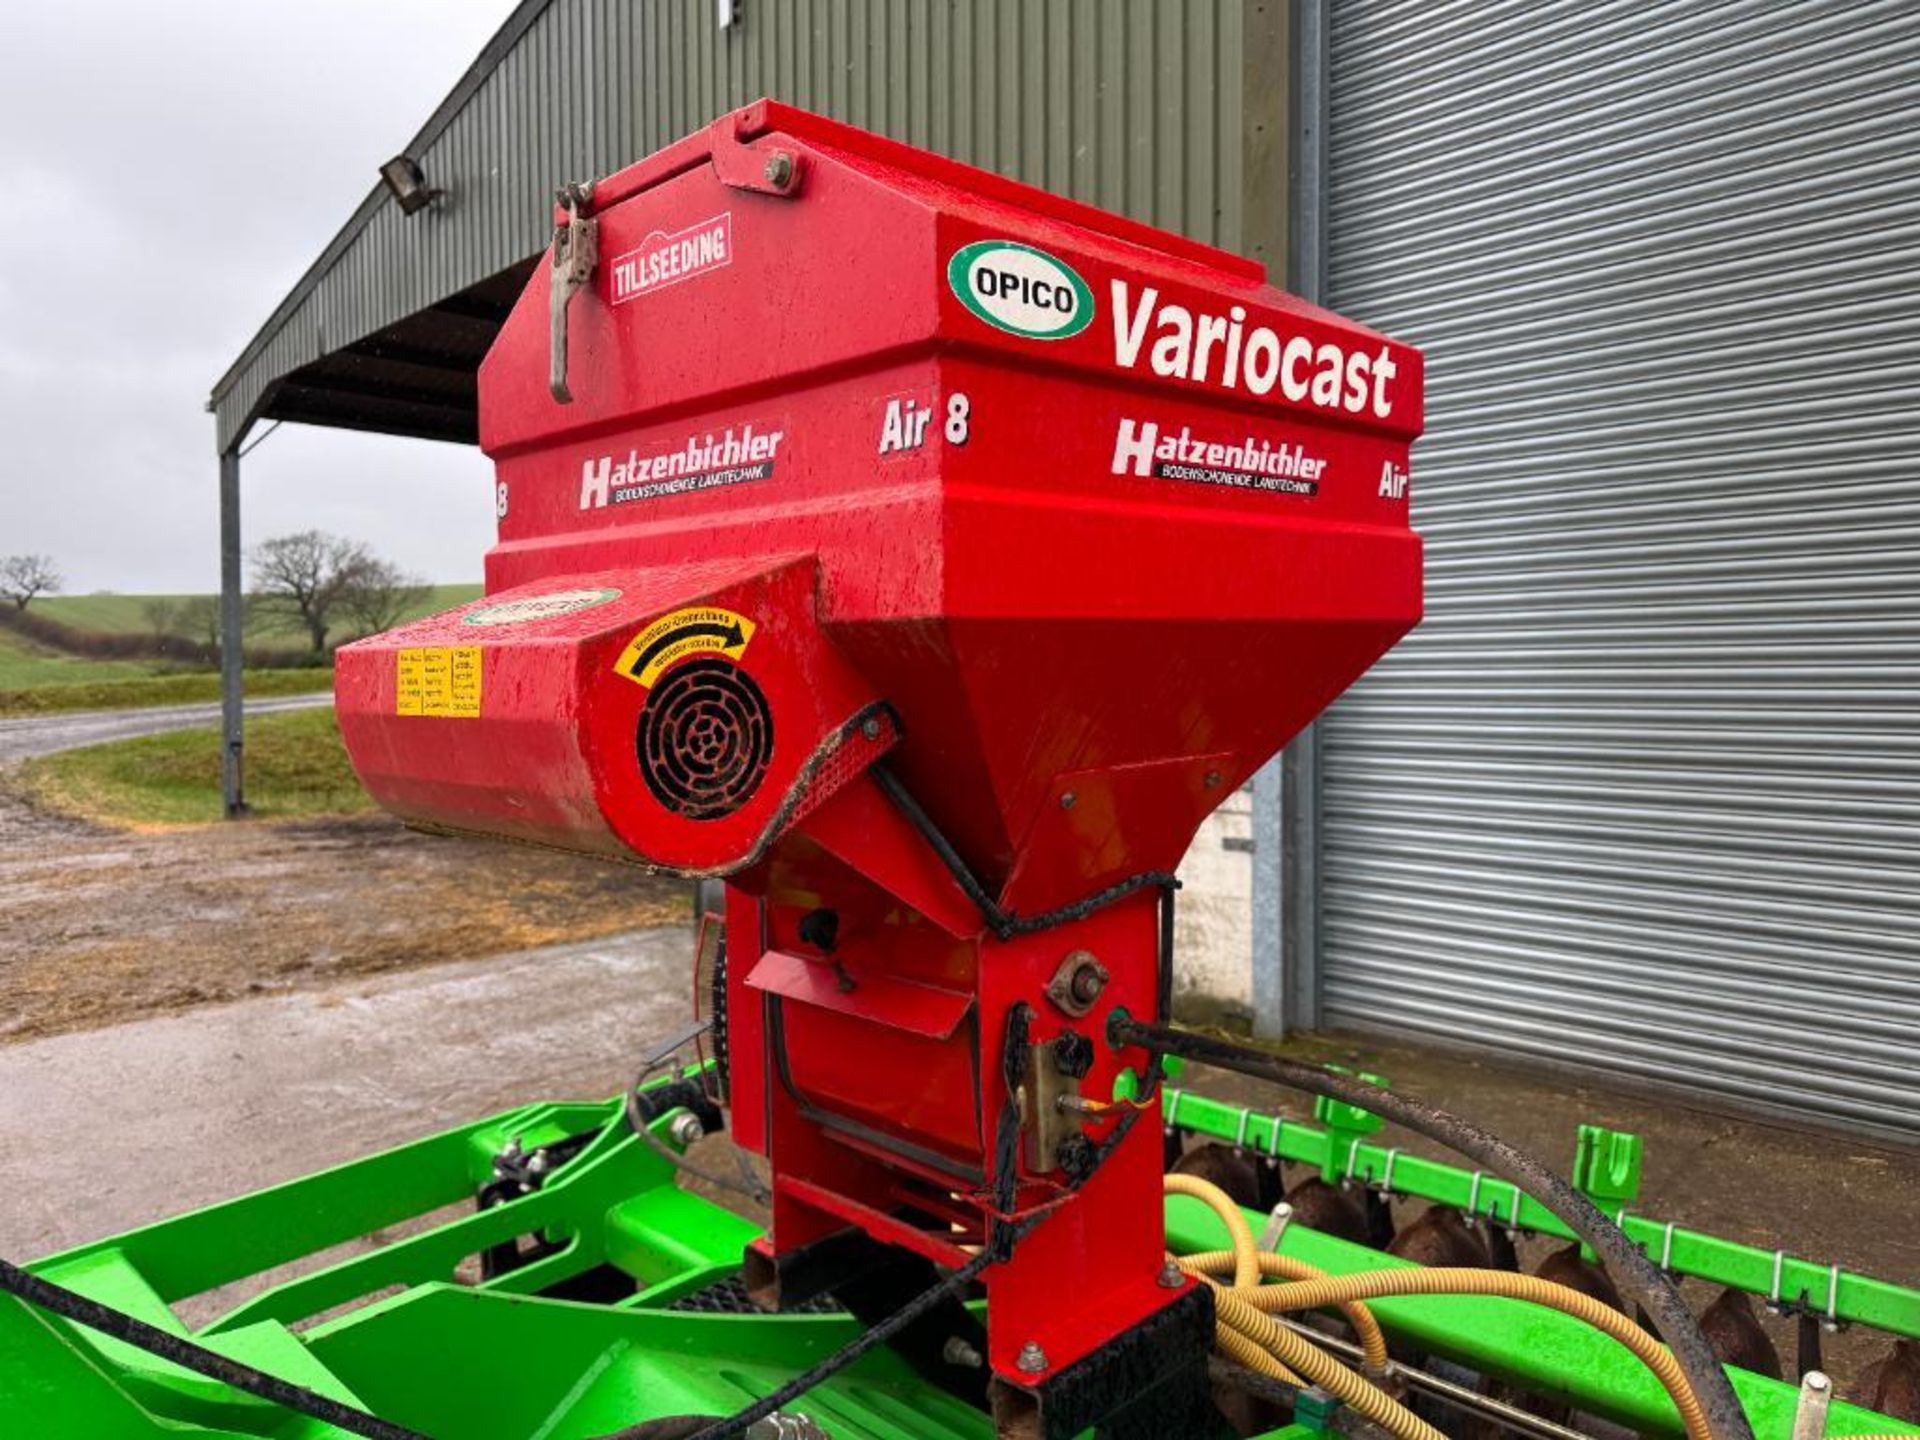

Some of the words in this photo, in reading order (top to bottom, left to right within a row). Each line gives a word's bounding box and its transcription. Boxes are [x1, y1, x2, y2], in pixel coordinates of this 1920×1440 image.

[615, 226, 725, 297] TILLSEEDING
[976, 266, 1073, 313] OPICO
[1110, 278, 1397, 419] Variocast
[879, 399, 932, 454] Air
[944, 392, 970, 445] 8
[1110, 418, 1327, 481] Hatzenbichler
[579, 425, 784, 510] Hatzenbichler
[1378, 460, 1407, 499] Air
